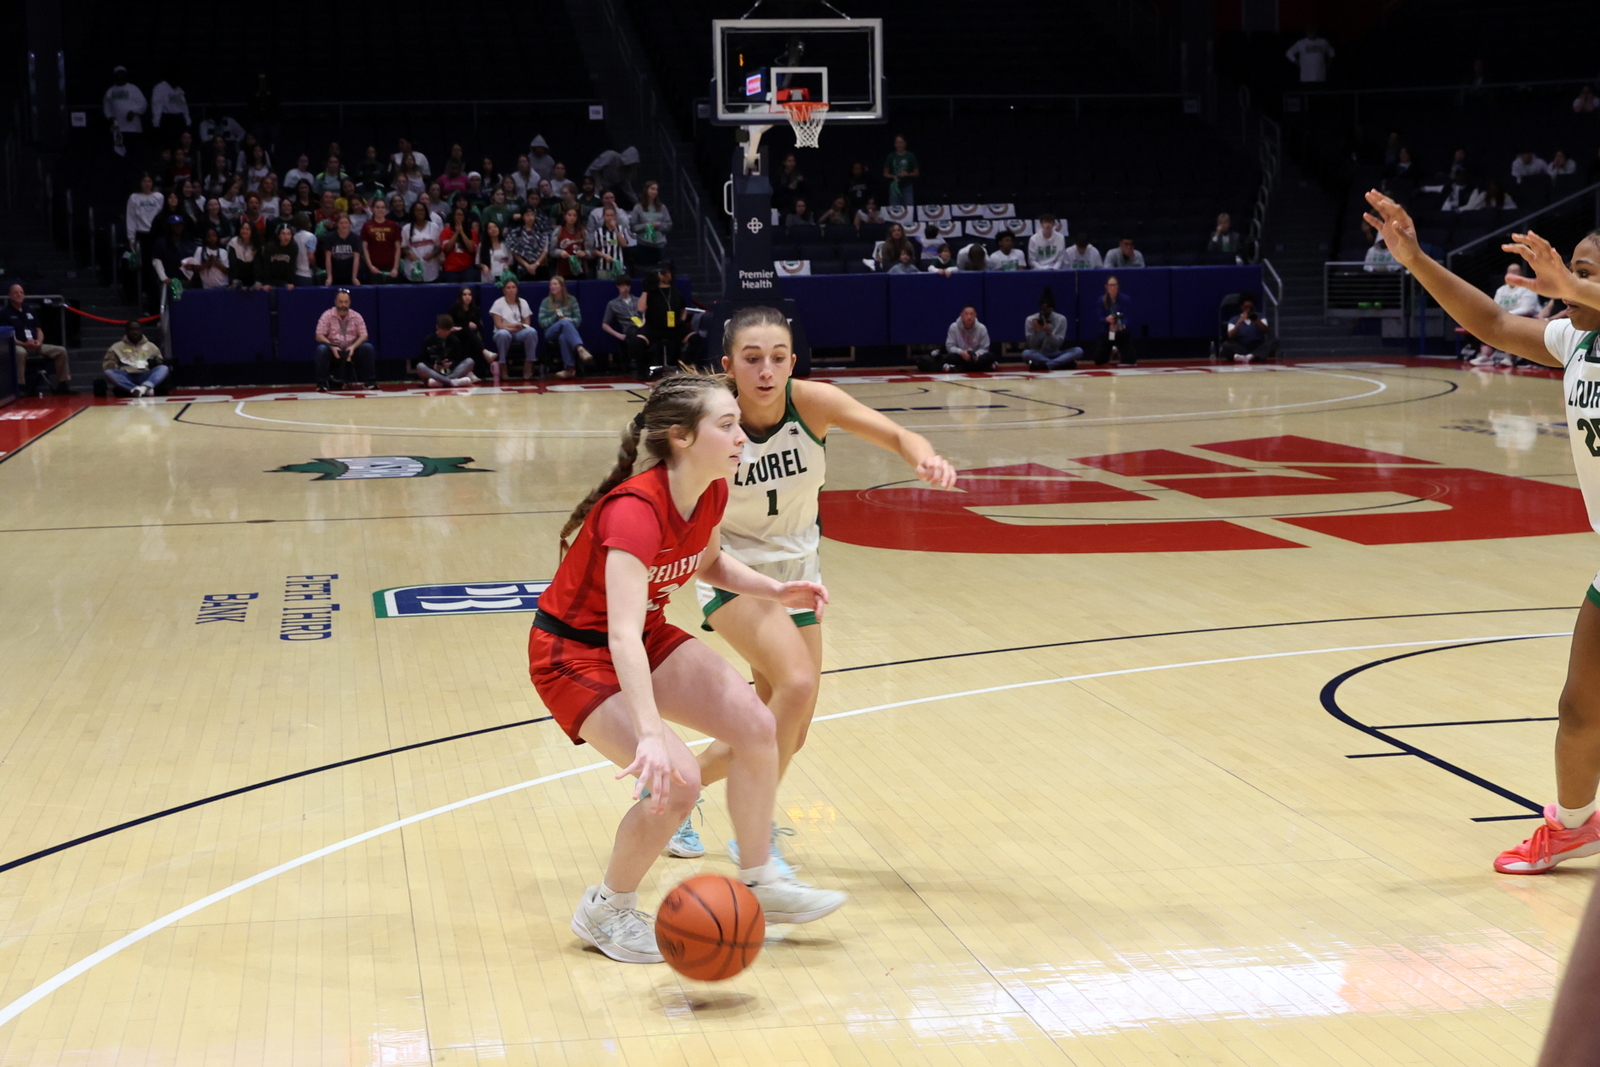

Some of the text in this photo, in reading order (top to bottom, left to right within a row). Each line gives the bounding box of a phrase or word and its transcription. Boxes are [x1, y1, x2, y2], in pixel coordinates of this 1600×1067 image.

[738, 269, 775, 280] Premier
[741, 279, 773, 289] Health
[114, 381, 646, 405] DAYTO
[734, 448, 807, 486] LAUREL
[766, 489, 778, 516] 1
[195, 592, 259, 625] BANK
